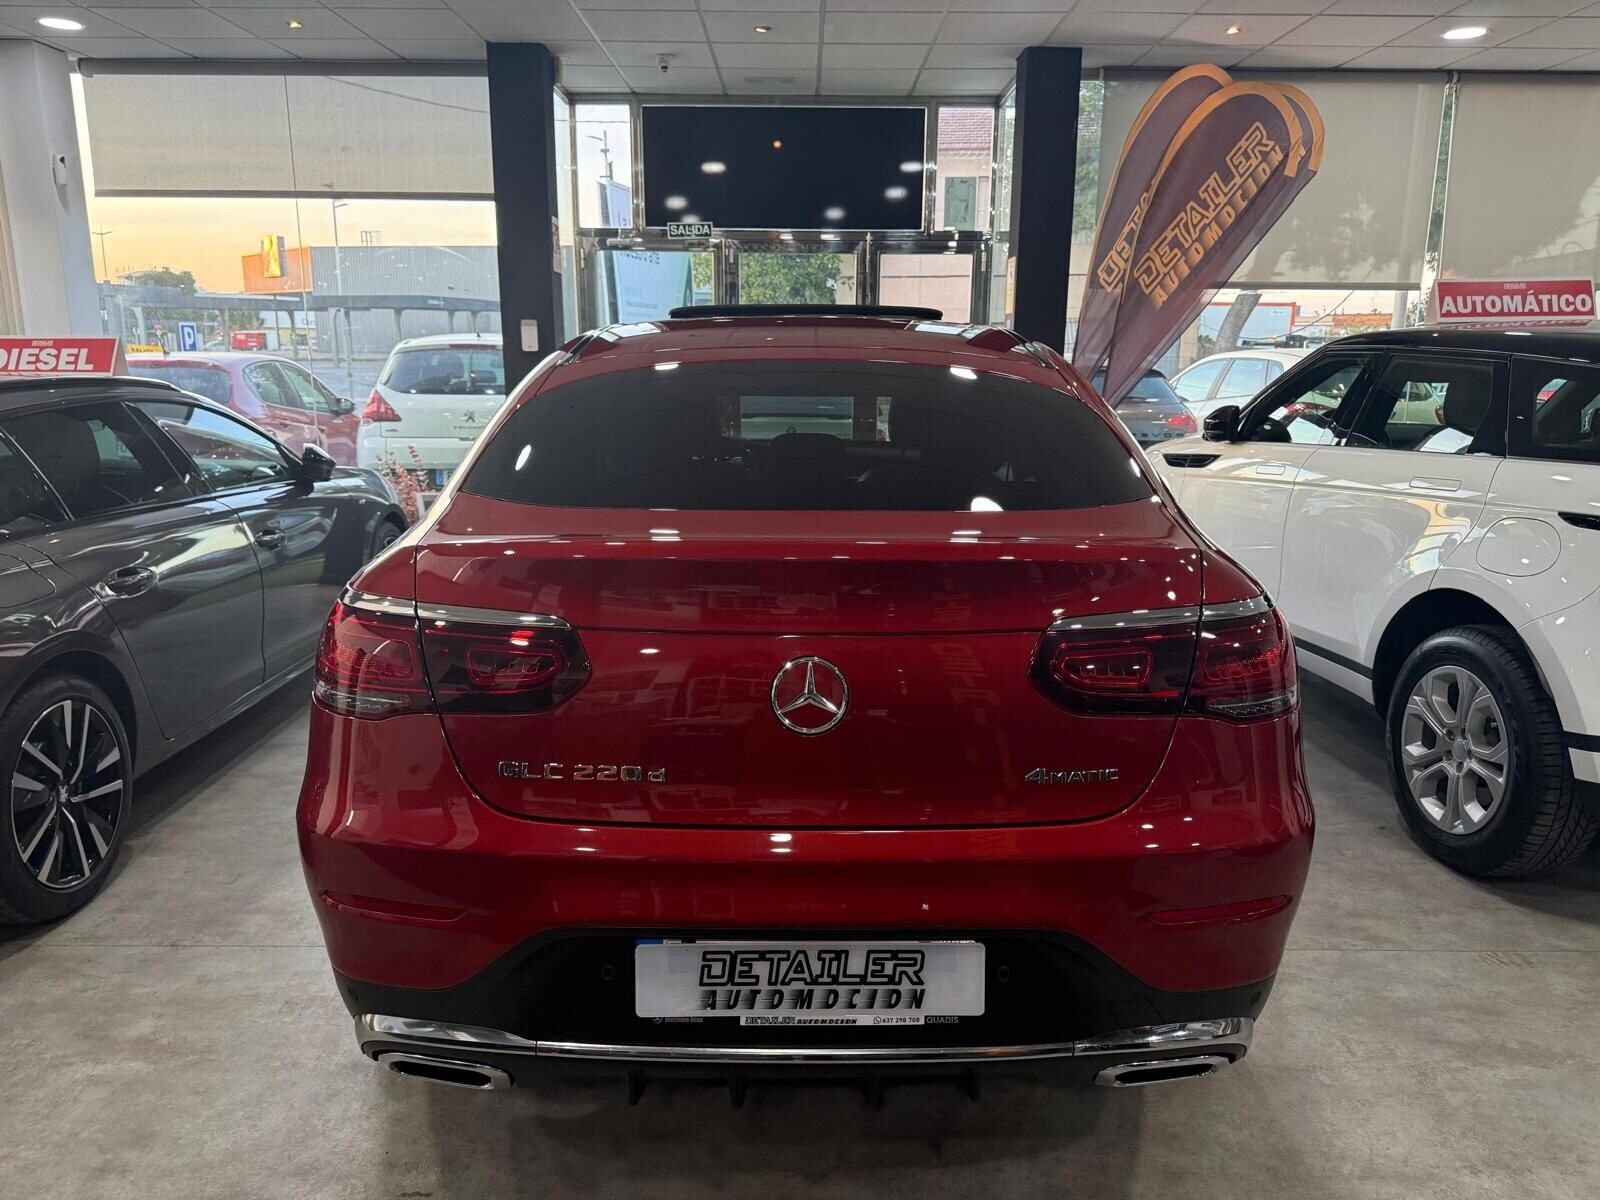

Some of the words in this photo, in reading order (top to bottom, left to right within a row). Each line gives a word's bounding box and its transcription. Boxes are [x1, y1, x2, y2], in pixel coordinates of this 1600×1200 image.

[1134, 121, 1276, 295] DETAILER
[670, 224, 711, 235] SALIDA
[1149, 144, 1284, 311] AUTOMOCION
[1440, 290, 1593, 314] AUTOMÁTICO
[183, 326, 194, 350] P
[498, 761, 564, 779] GLC
[573, 764, 642, 781] 220
[647, 768, 666, 782] d
[1024, 767, 1119, 784] 4MATIC
[699, 950, 926, 986] DETAILER
[697, 989, 926, 1010] AUTOMOCION
[744, 1016, 796, 1025] DETAILER
[926, 1016, 959, 1024] QUADIS
